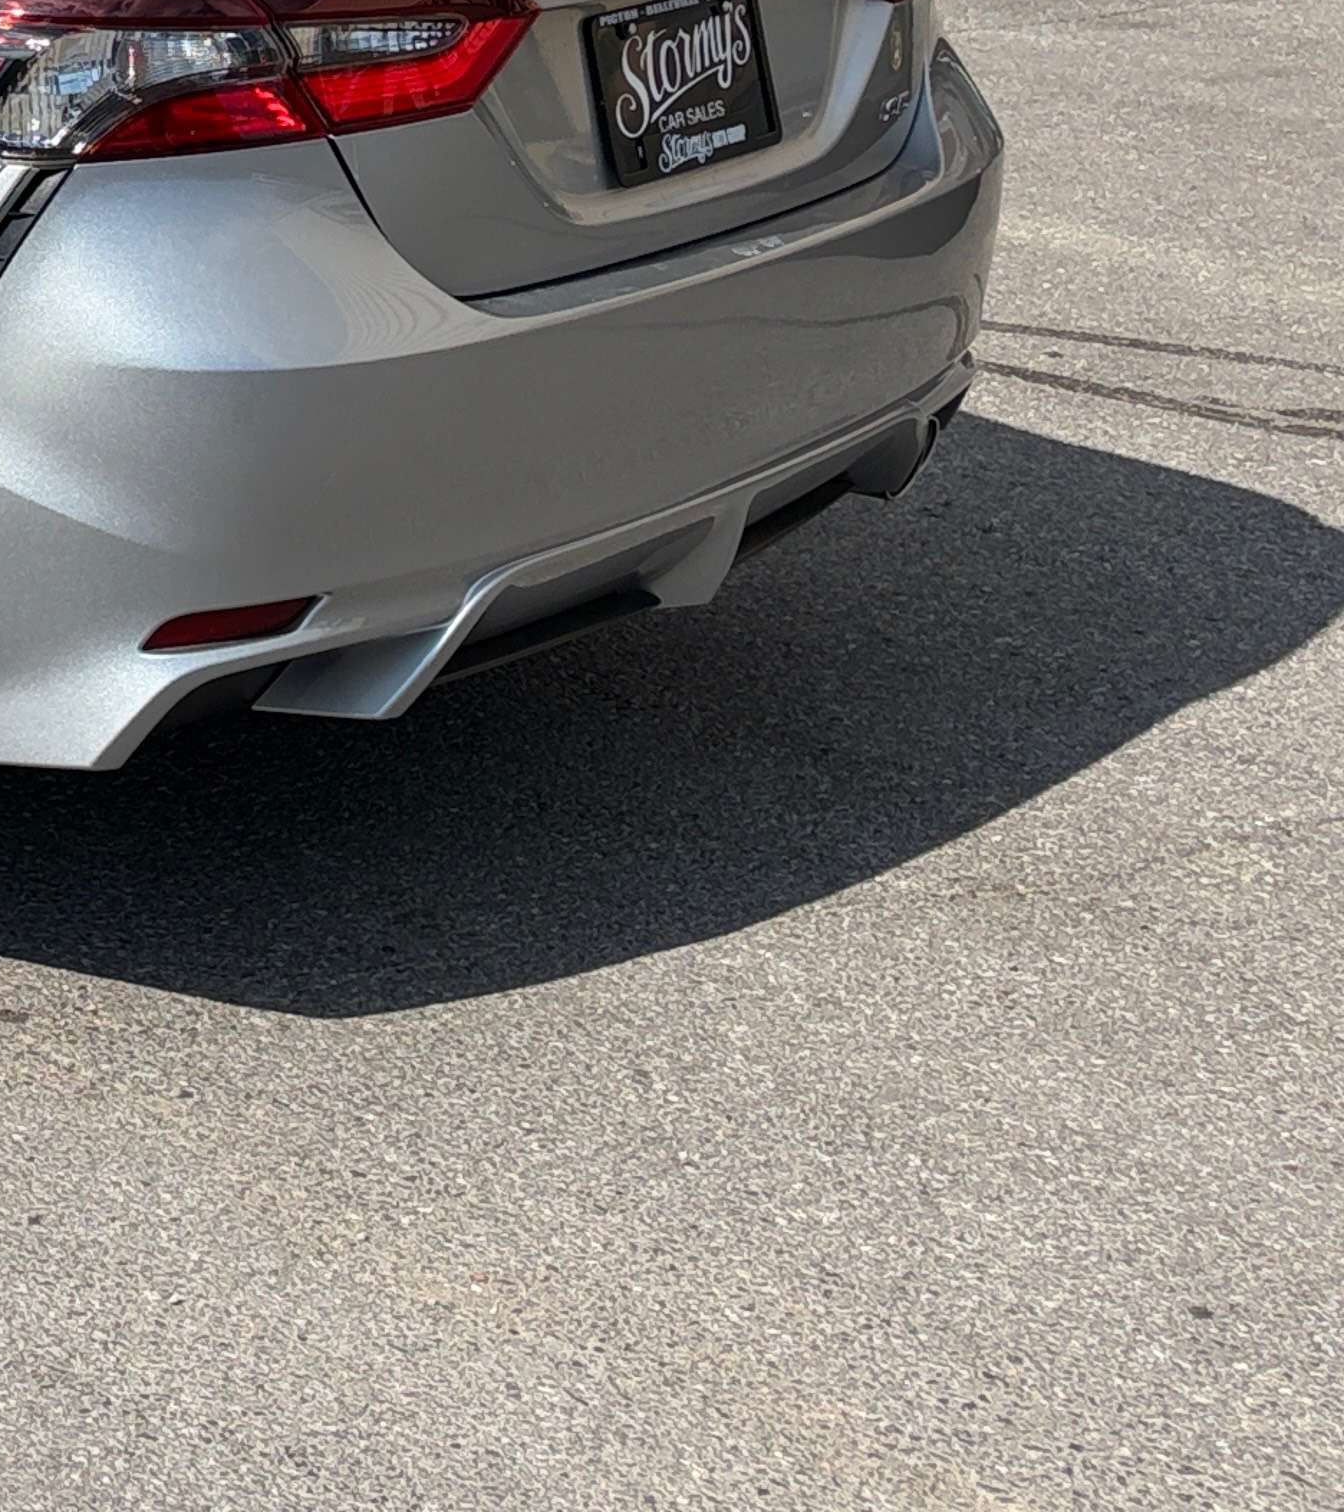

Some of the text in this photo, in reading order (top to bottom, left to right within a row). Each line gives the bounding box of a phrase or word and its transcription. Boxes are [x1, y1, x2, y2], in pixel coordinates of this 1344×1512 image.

[599, 8, 639, 27] PICTON
[615, 0, 752, 138] Stormy's
[658, 100, 726, 133] CAR SALES
